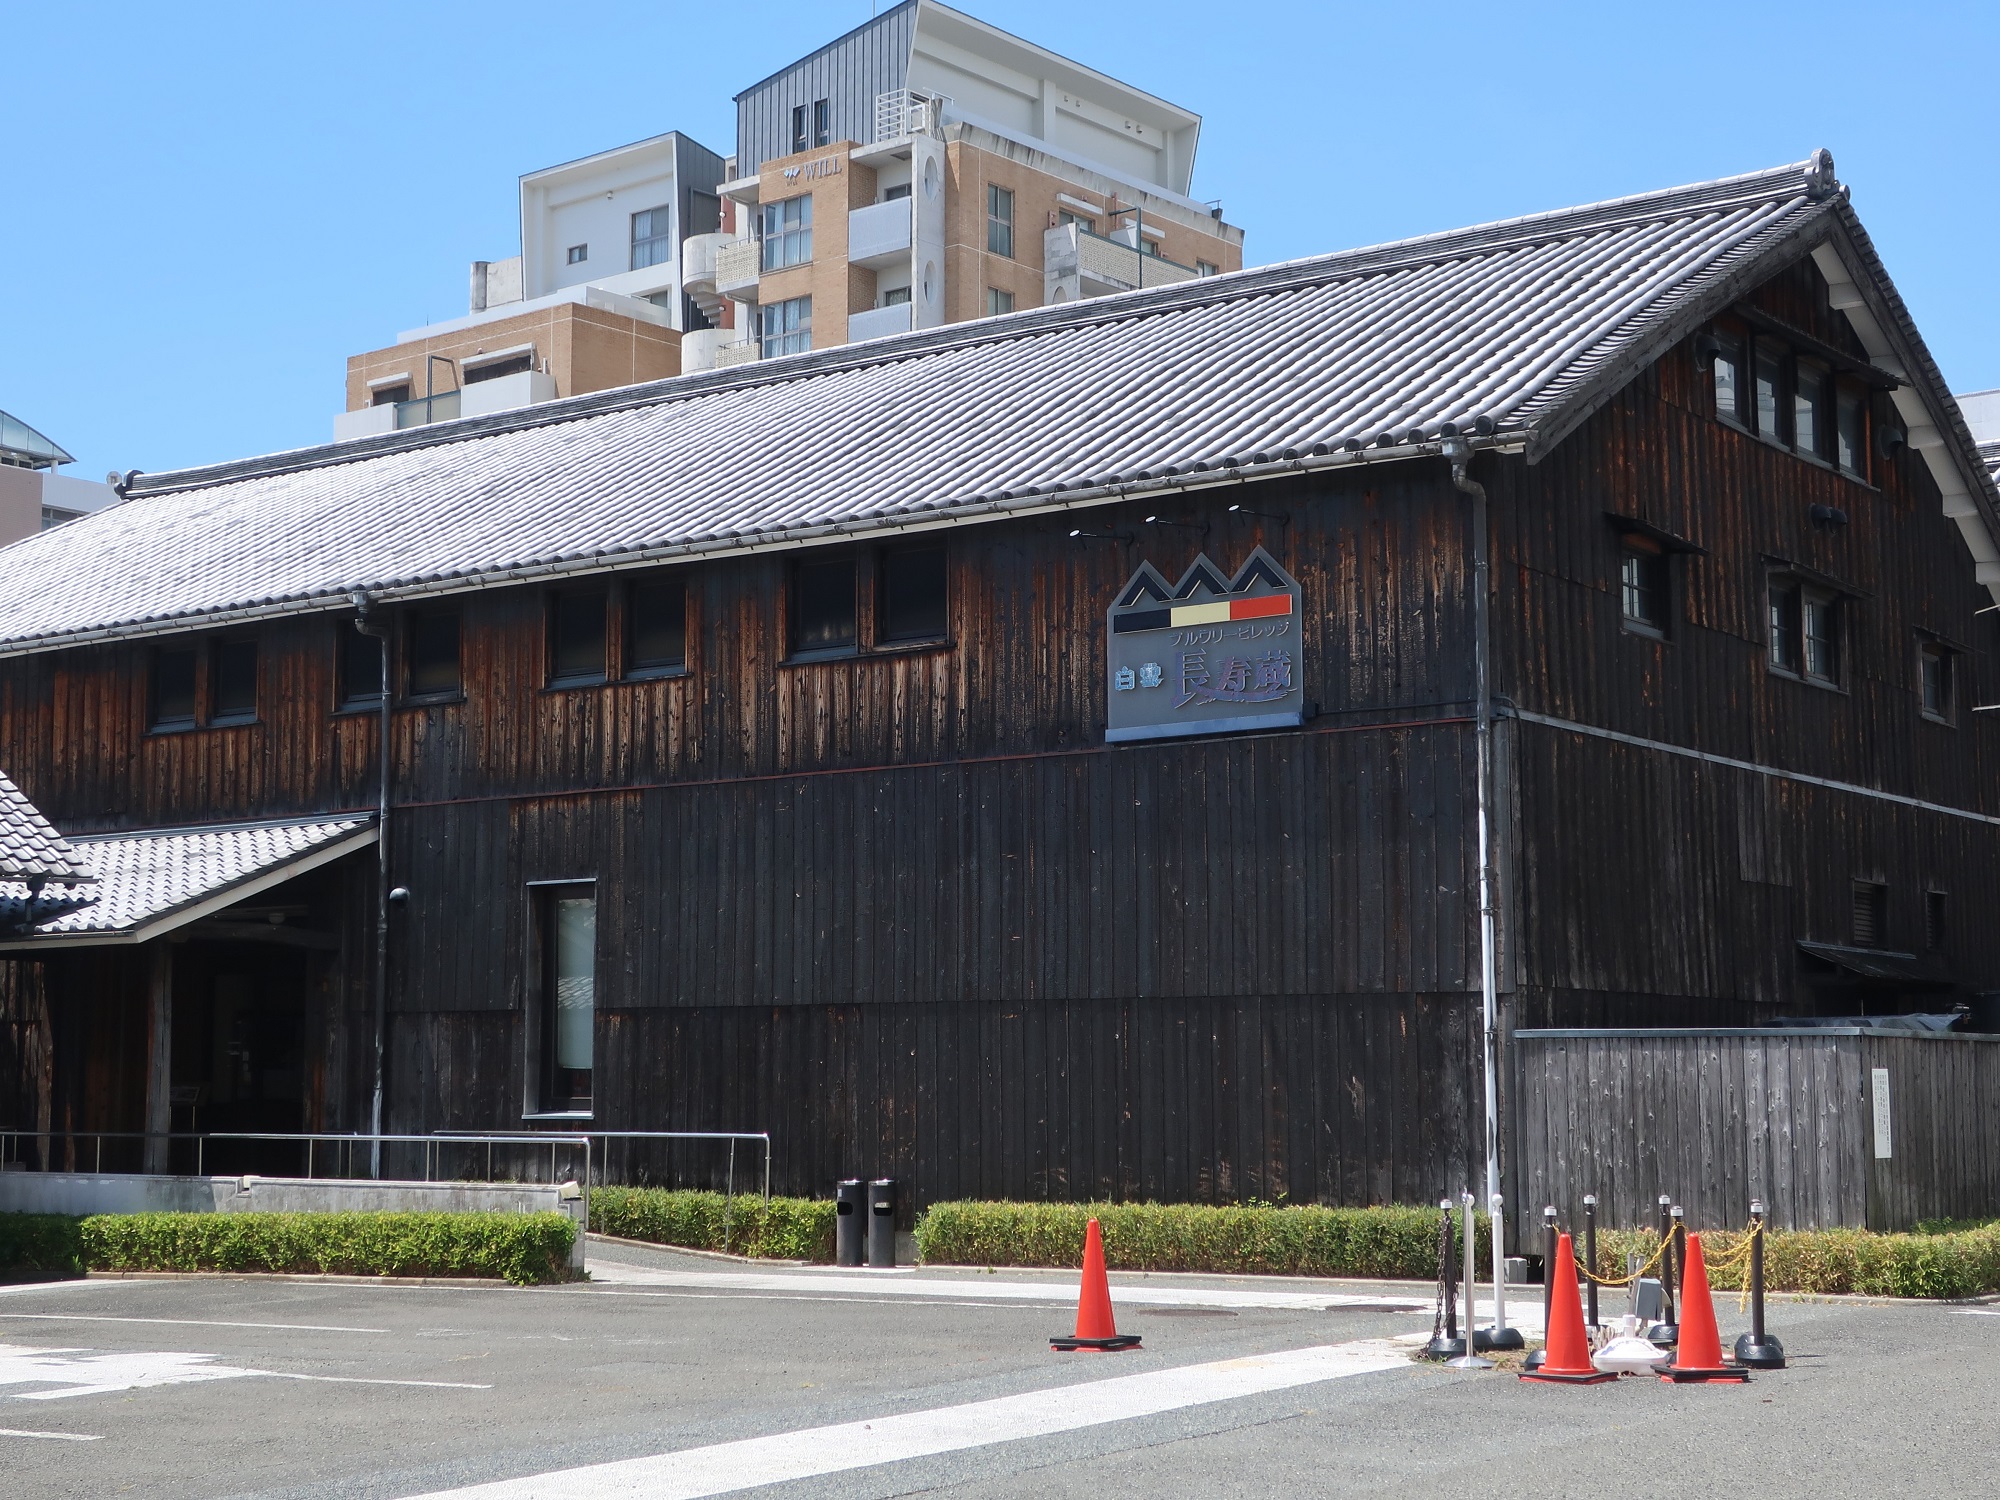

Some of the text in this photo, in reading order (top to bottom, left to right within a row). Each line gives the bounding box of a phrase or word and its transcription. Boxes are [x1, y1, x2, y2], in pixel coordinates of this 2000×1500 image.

[803, 157, 842, 181] WILL
[1171, 648, 1298, 709] 長寿蔵
